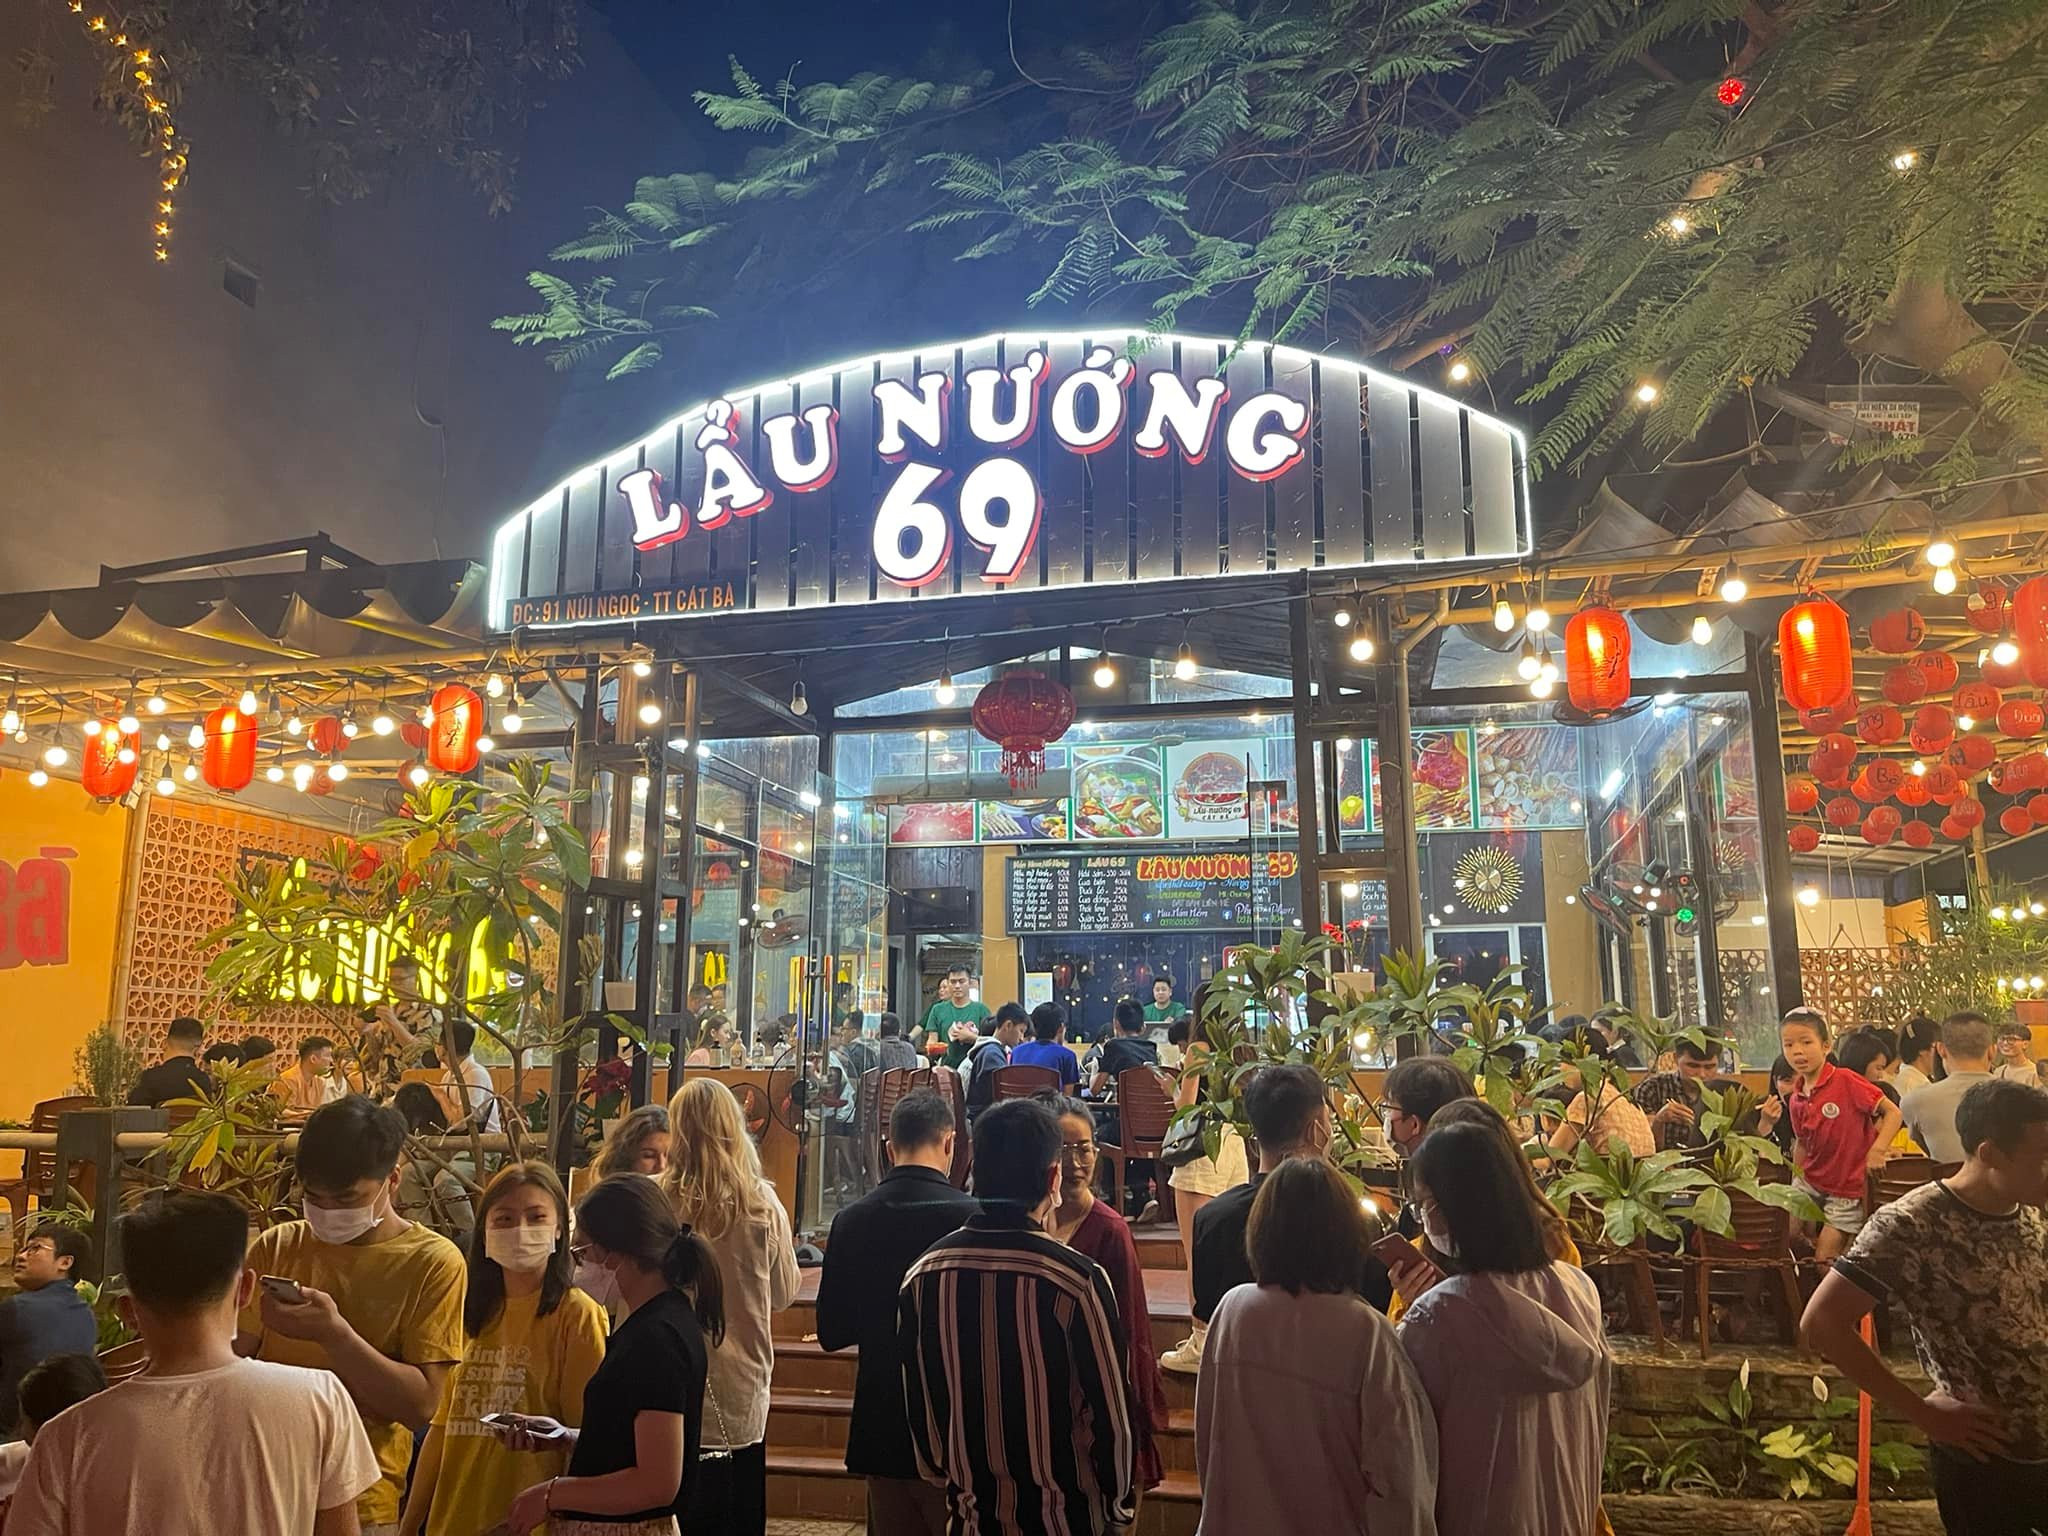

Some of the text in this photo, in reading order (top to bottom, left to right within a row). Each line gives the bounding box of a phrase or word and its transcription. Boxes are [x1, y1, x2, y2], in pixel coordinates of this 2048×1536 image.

[617, 346, 1311, 551] LẨU NƯỚNG
[872, 457, 1044, 587] 69
[567, 595, 593, 620] NÚI
[598, 593, 641, 620] NGỌC
[653, 591, 672, 614] TT
[676, 585, 708, 612] CÁT
[712, 582, 735, 608] BÀ
[1267, 852, 1295, 877] 69
